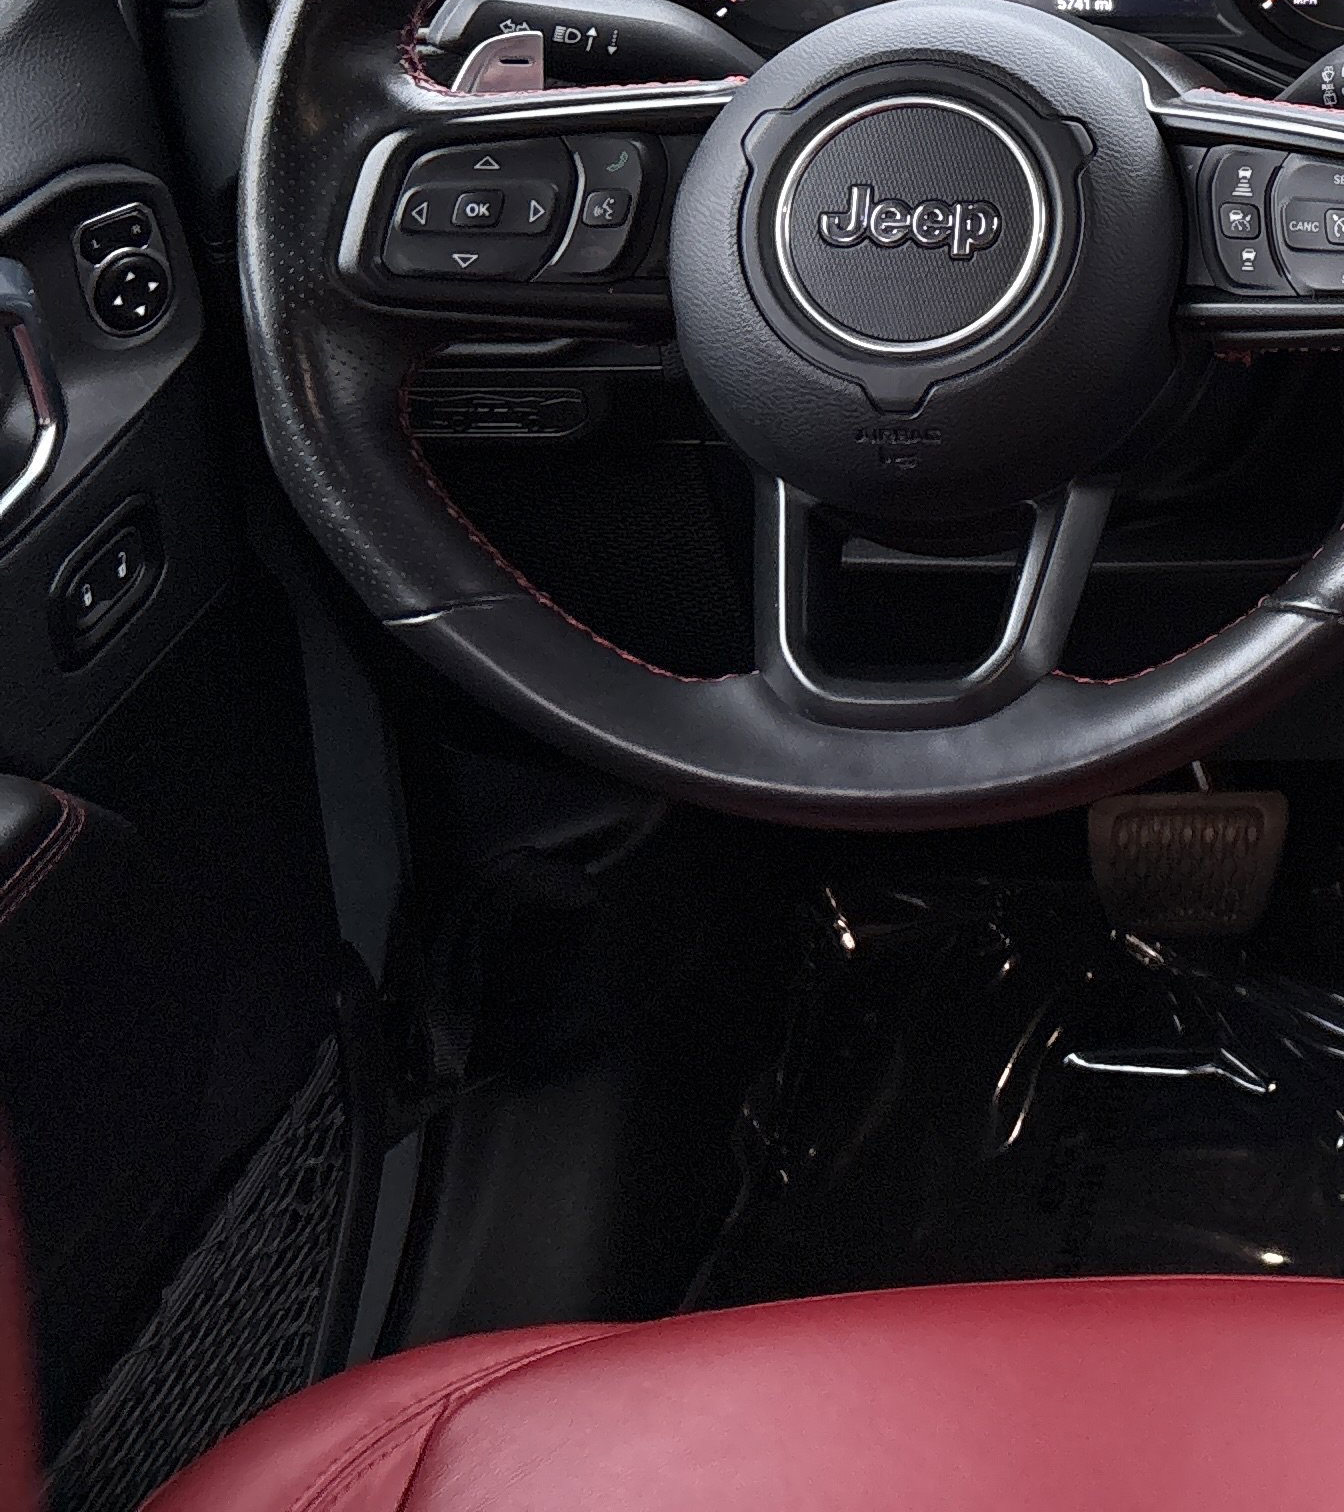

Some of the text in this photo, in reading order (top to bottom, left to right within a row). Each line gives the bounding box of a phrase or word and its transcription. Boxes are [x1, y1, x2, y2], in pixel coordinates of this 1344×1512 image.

[465, 202, 491, 218] OK
[820, 184, 1002, 261] Jeep
[1289, 220, 1320, 232] CANC
